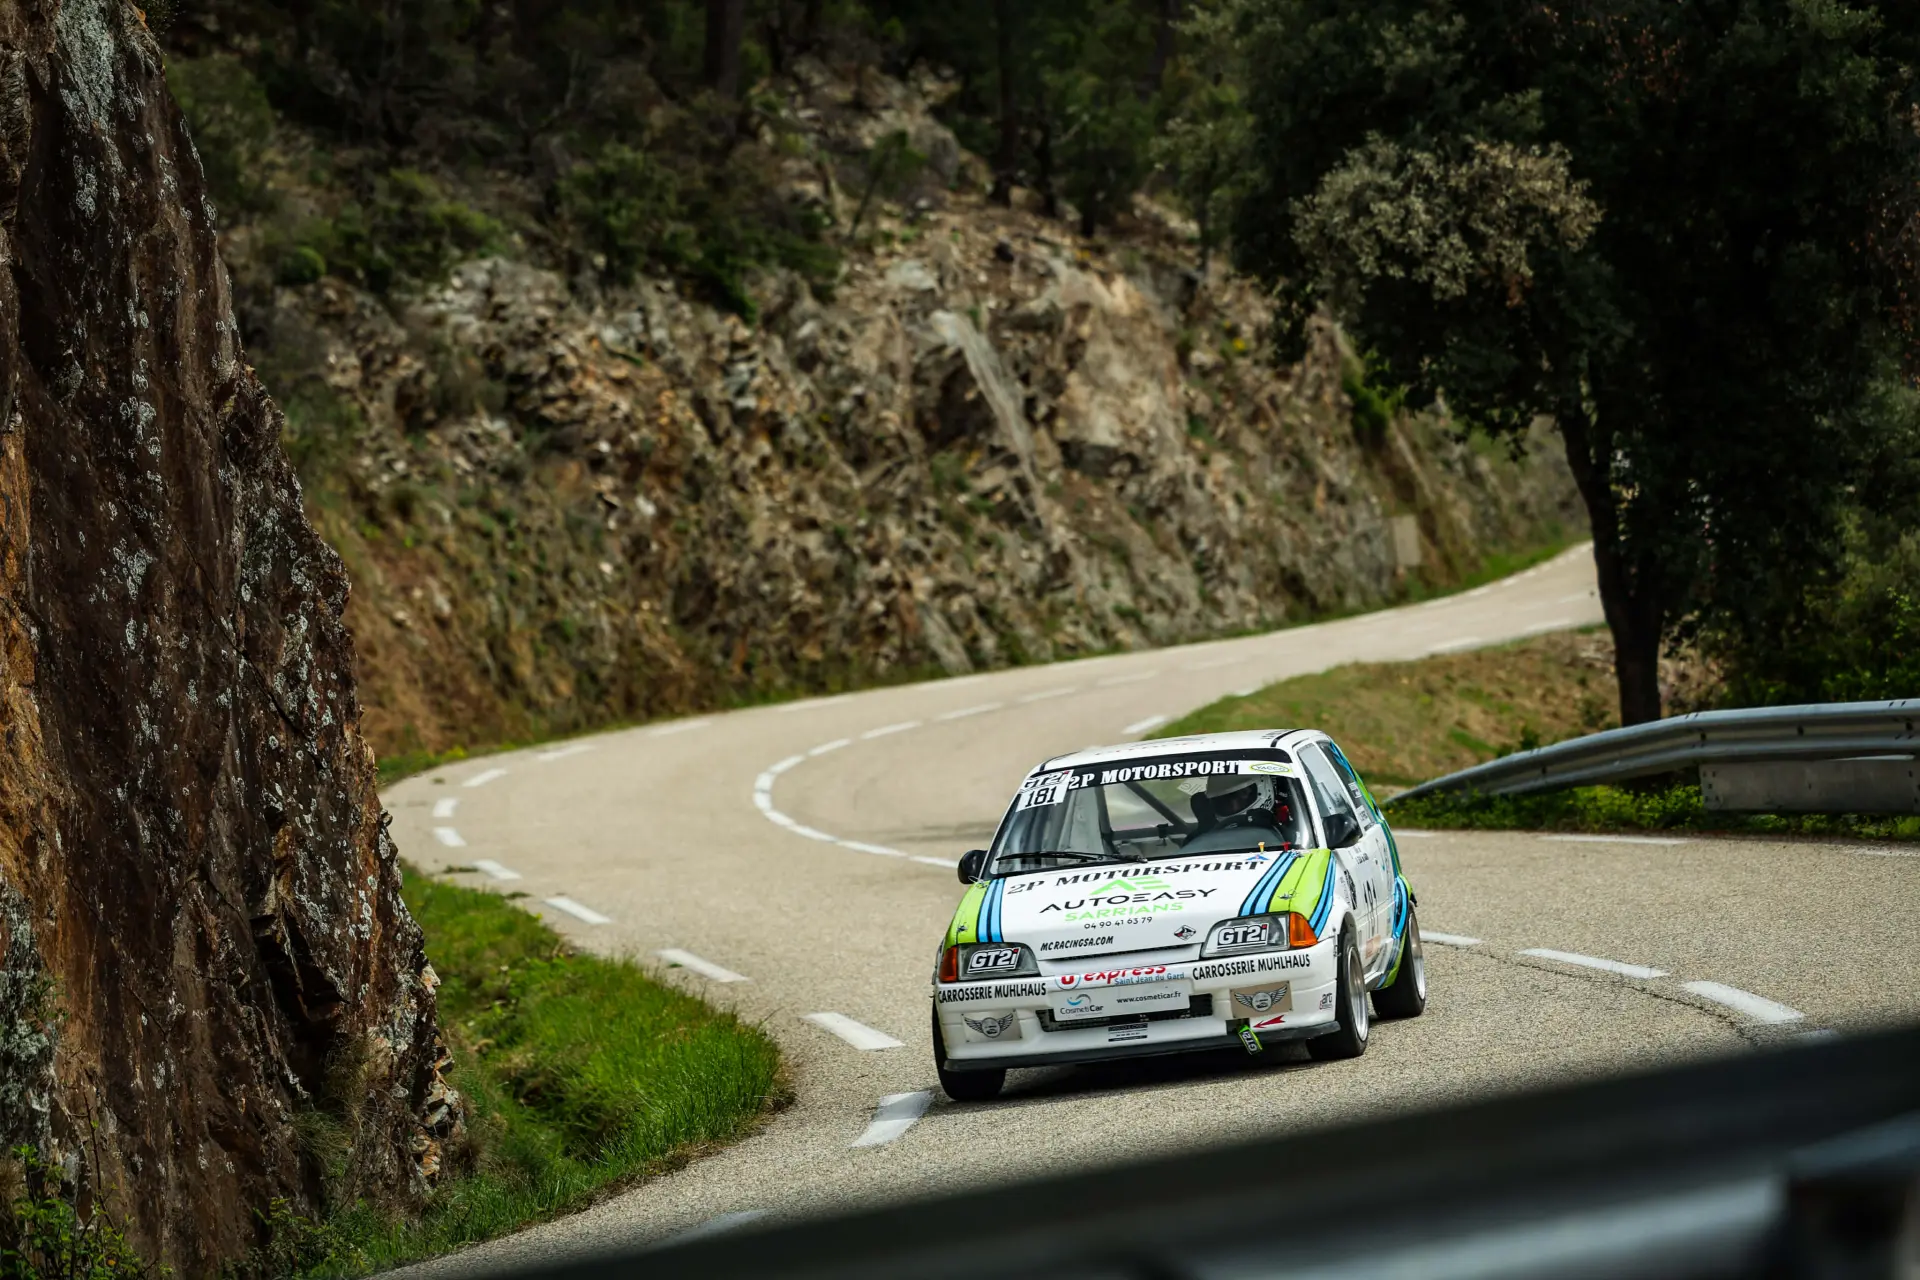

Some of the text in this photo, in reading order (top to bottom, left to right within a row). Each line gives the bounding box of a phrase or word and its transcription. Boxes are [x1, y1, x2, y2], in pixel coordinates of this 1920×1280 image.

[1068, 760, 1239, 790] 2P MOTORSPORT
[1025, 786, 1058, 808] 181
[1007, 861, 1264, 895] 2P MOTORSPORT
[1039, 888, 1218, 914] AUTOEASY
[1065, 902, 1184, 922] SARRIANS
[1084, 916, 1153, 930] 04 90 41 63 79
[1218, 923, 1268, 946] GT2i
[971, 948, 1019, 968] GT2i
[1192, 953, 1311, 981] CARROSSERIE MUHLHAUS
[1114, 971, 1185, 985] Saint Jean du Gard
[938, 982, 1047, 1004] CARROSSERIE MUHLHAUS
[1116, 991, 1181, 1004] www.cosmeticar.fr
[1059, 1004, 1104, 1015] CosmetiCar
